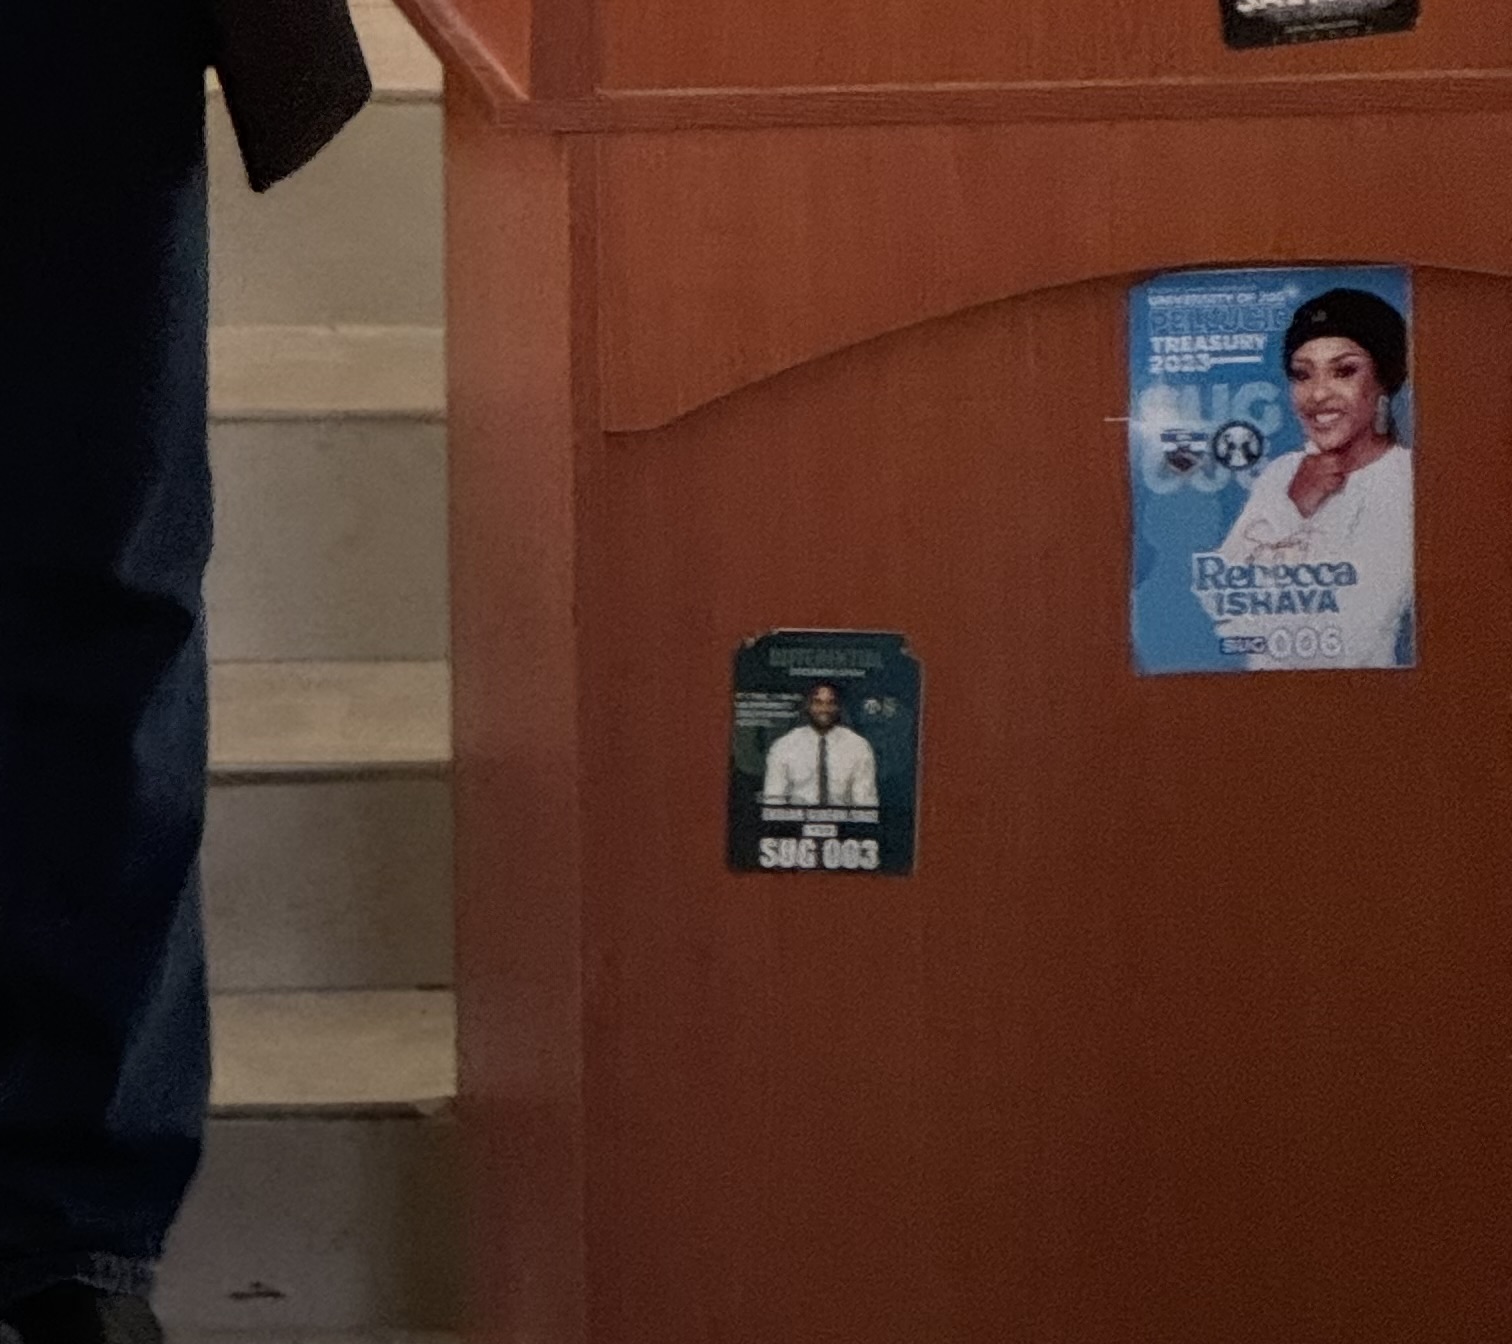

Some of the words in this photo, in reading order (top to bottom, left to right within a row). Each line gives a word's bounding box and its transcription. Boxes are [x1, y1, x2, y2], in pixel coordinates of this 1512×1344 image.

[1150, 334, 1267, 353] TREASURY
[1194, 556, 1358, 591] Rebecca
[1215, 589, 1339, 616] ISHAYA
[1268, 627, 1341, 659] 006
[759, 837, 817, 868] SUG
